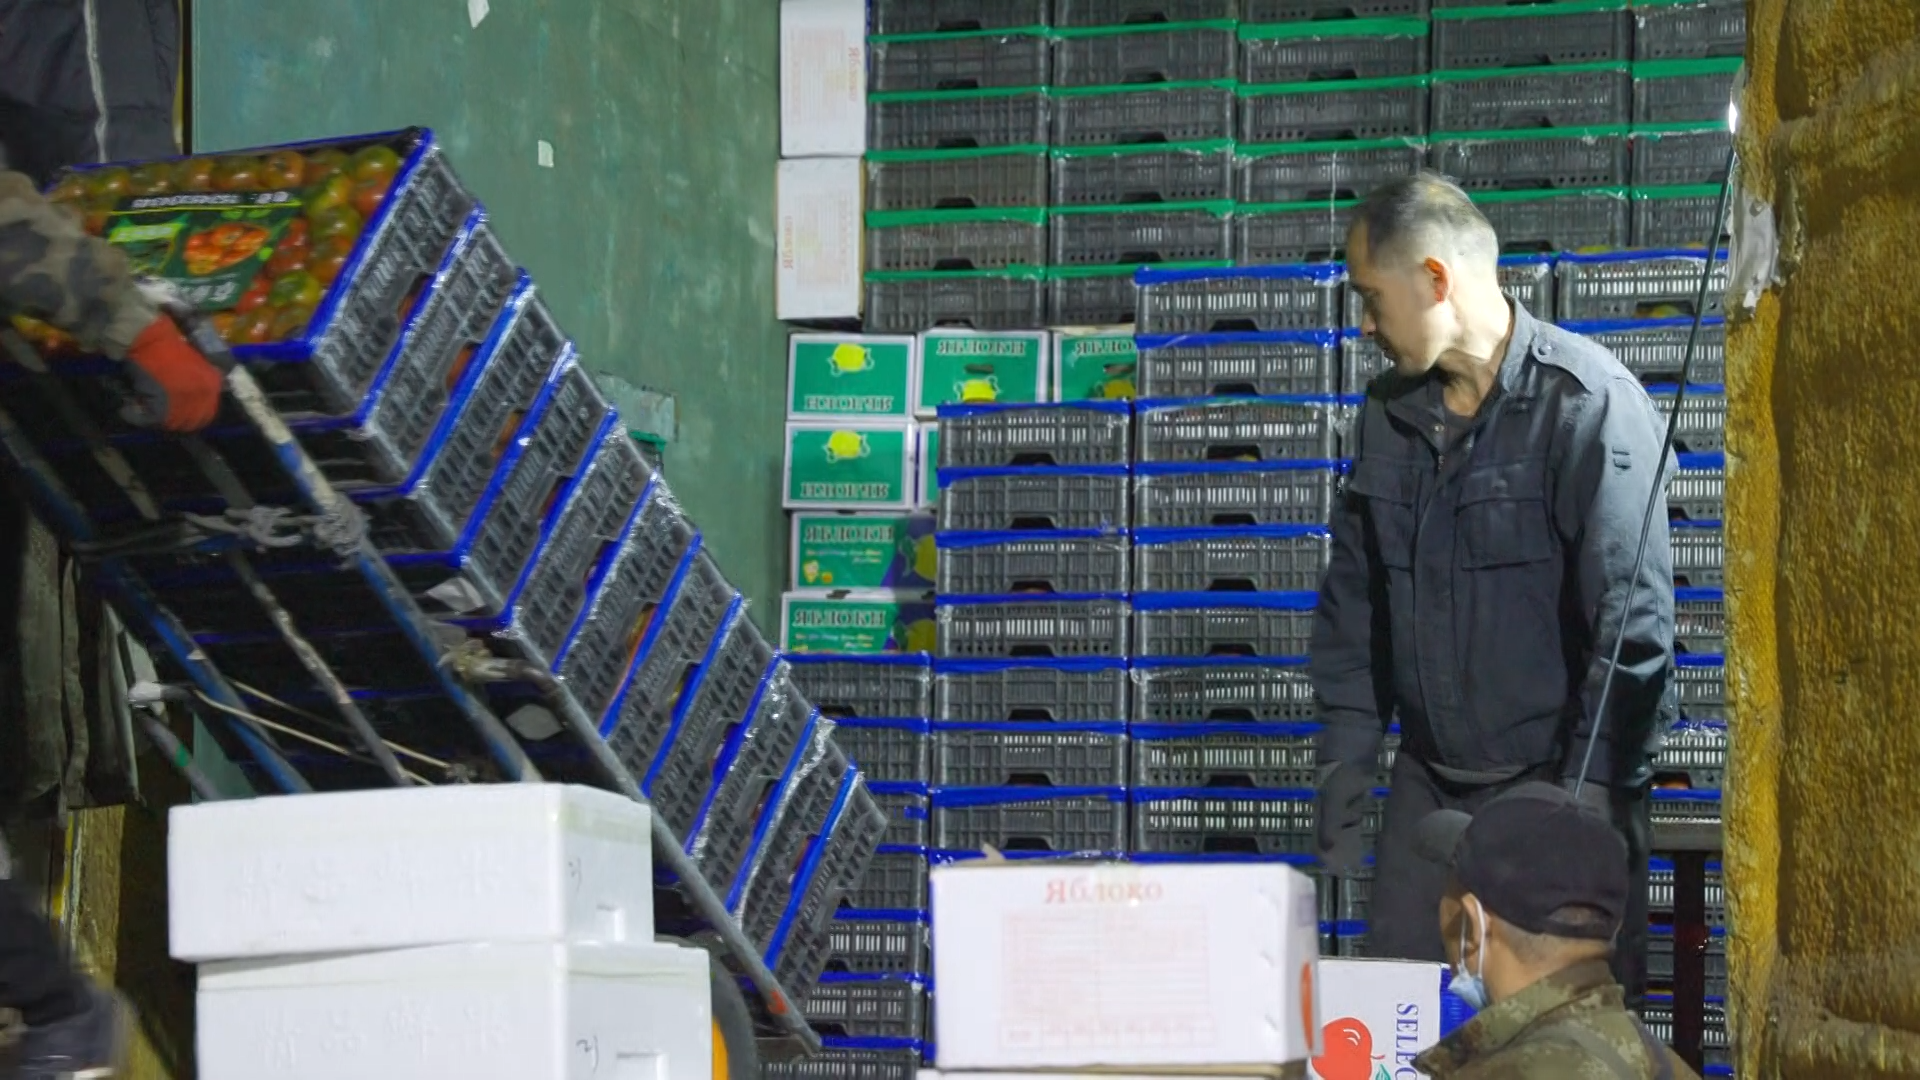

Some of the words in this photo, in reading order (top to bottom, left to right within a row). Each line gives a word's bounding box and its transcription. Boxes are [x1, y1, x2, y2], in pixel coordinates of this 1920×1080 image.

[936, 339, 1026, 356] ЯБЛОКИ
[803, 525, 894, 543] ЯБЛОКИ
[792, 608, 886, 627] ЯБЛОКИ
[1044, 879, 1164, 905] Яблоко
